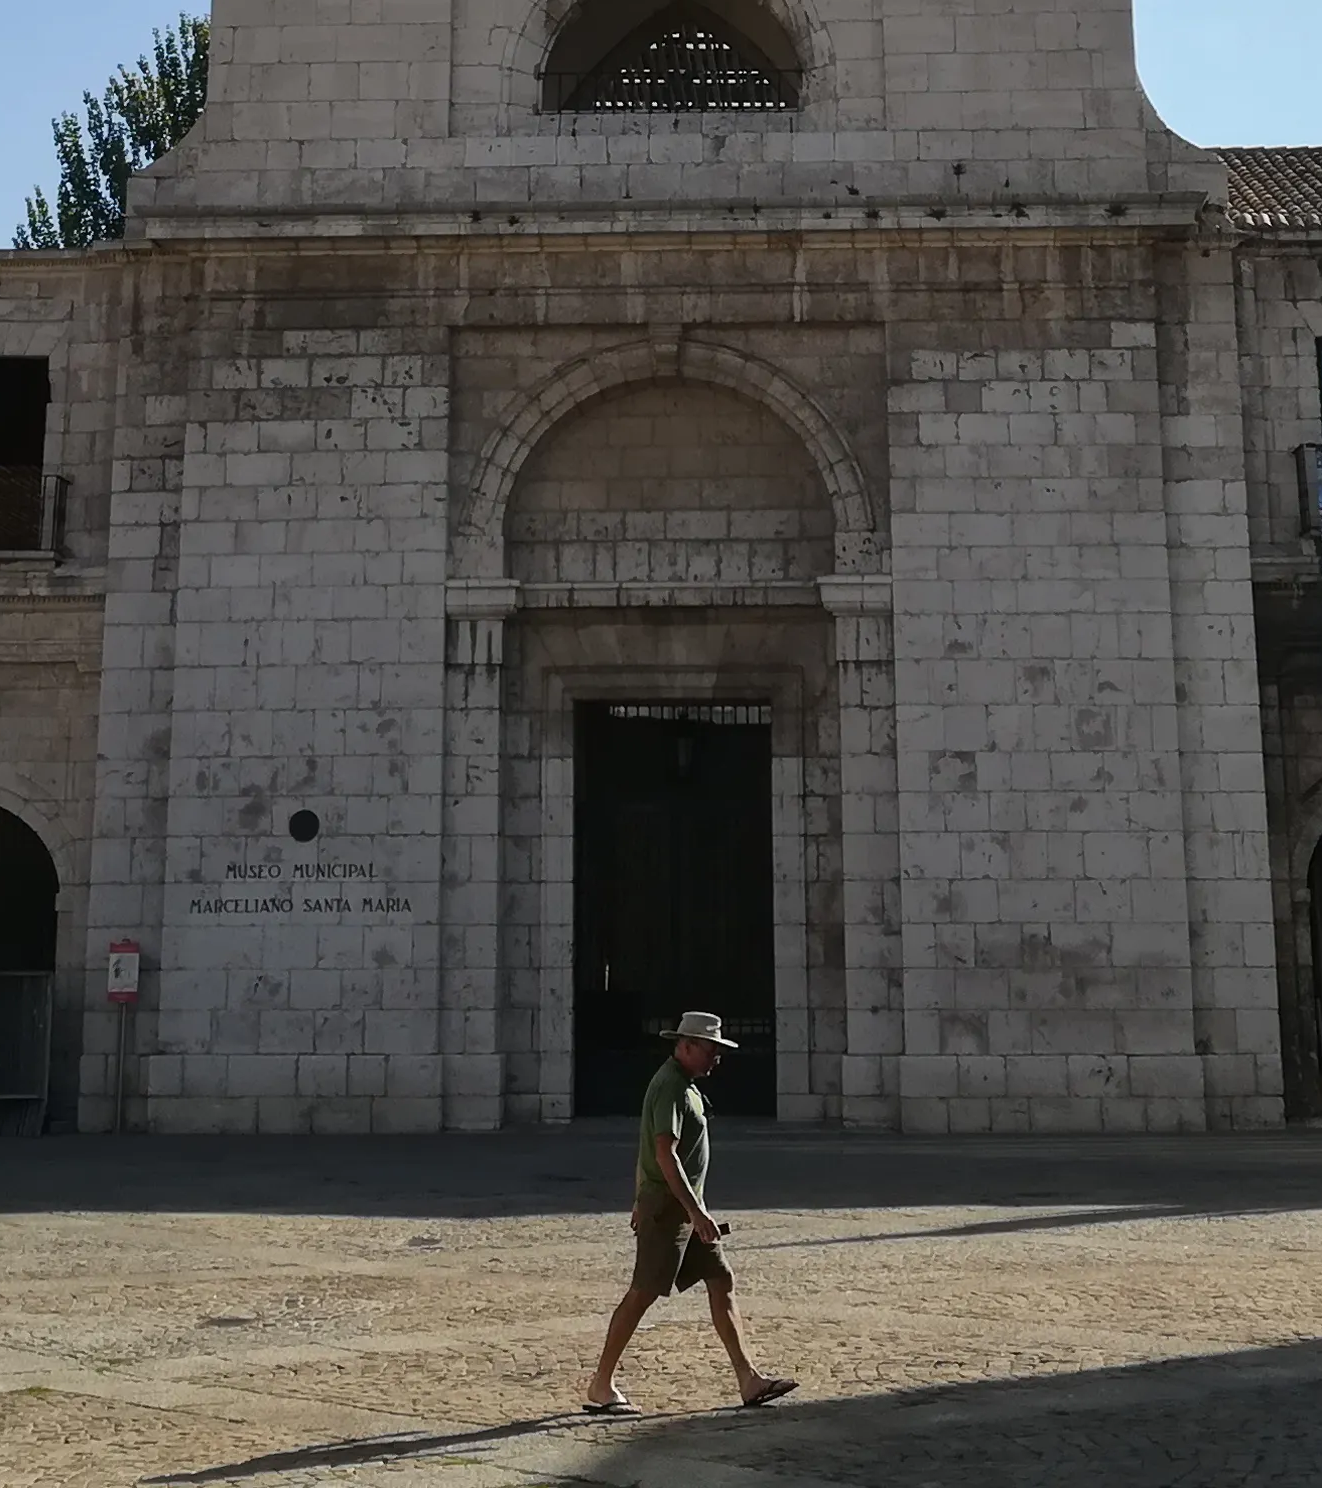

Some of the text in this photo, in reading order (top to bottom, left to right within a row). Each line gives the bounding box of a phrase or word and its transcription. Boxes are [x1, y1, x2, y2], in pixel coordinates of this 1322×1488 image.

[225, 862, 379, 879] MUSEO MUNICIPAL
[189, 897, 413, 914] MARCELIANO SANTA MARIA
